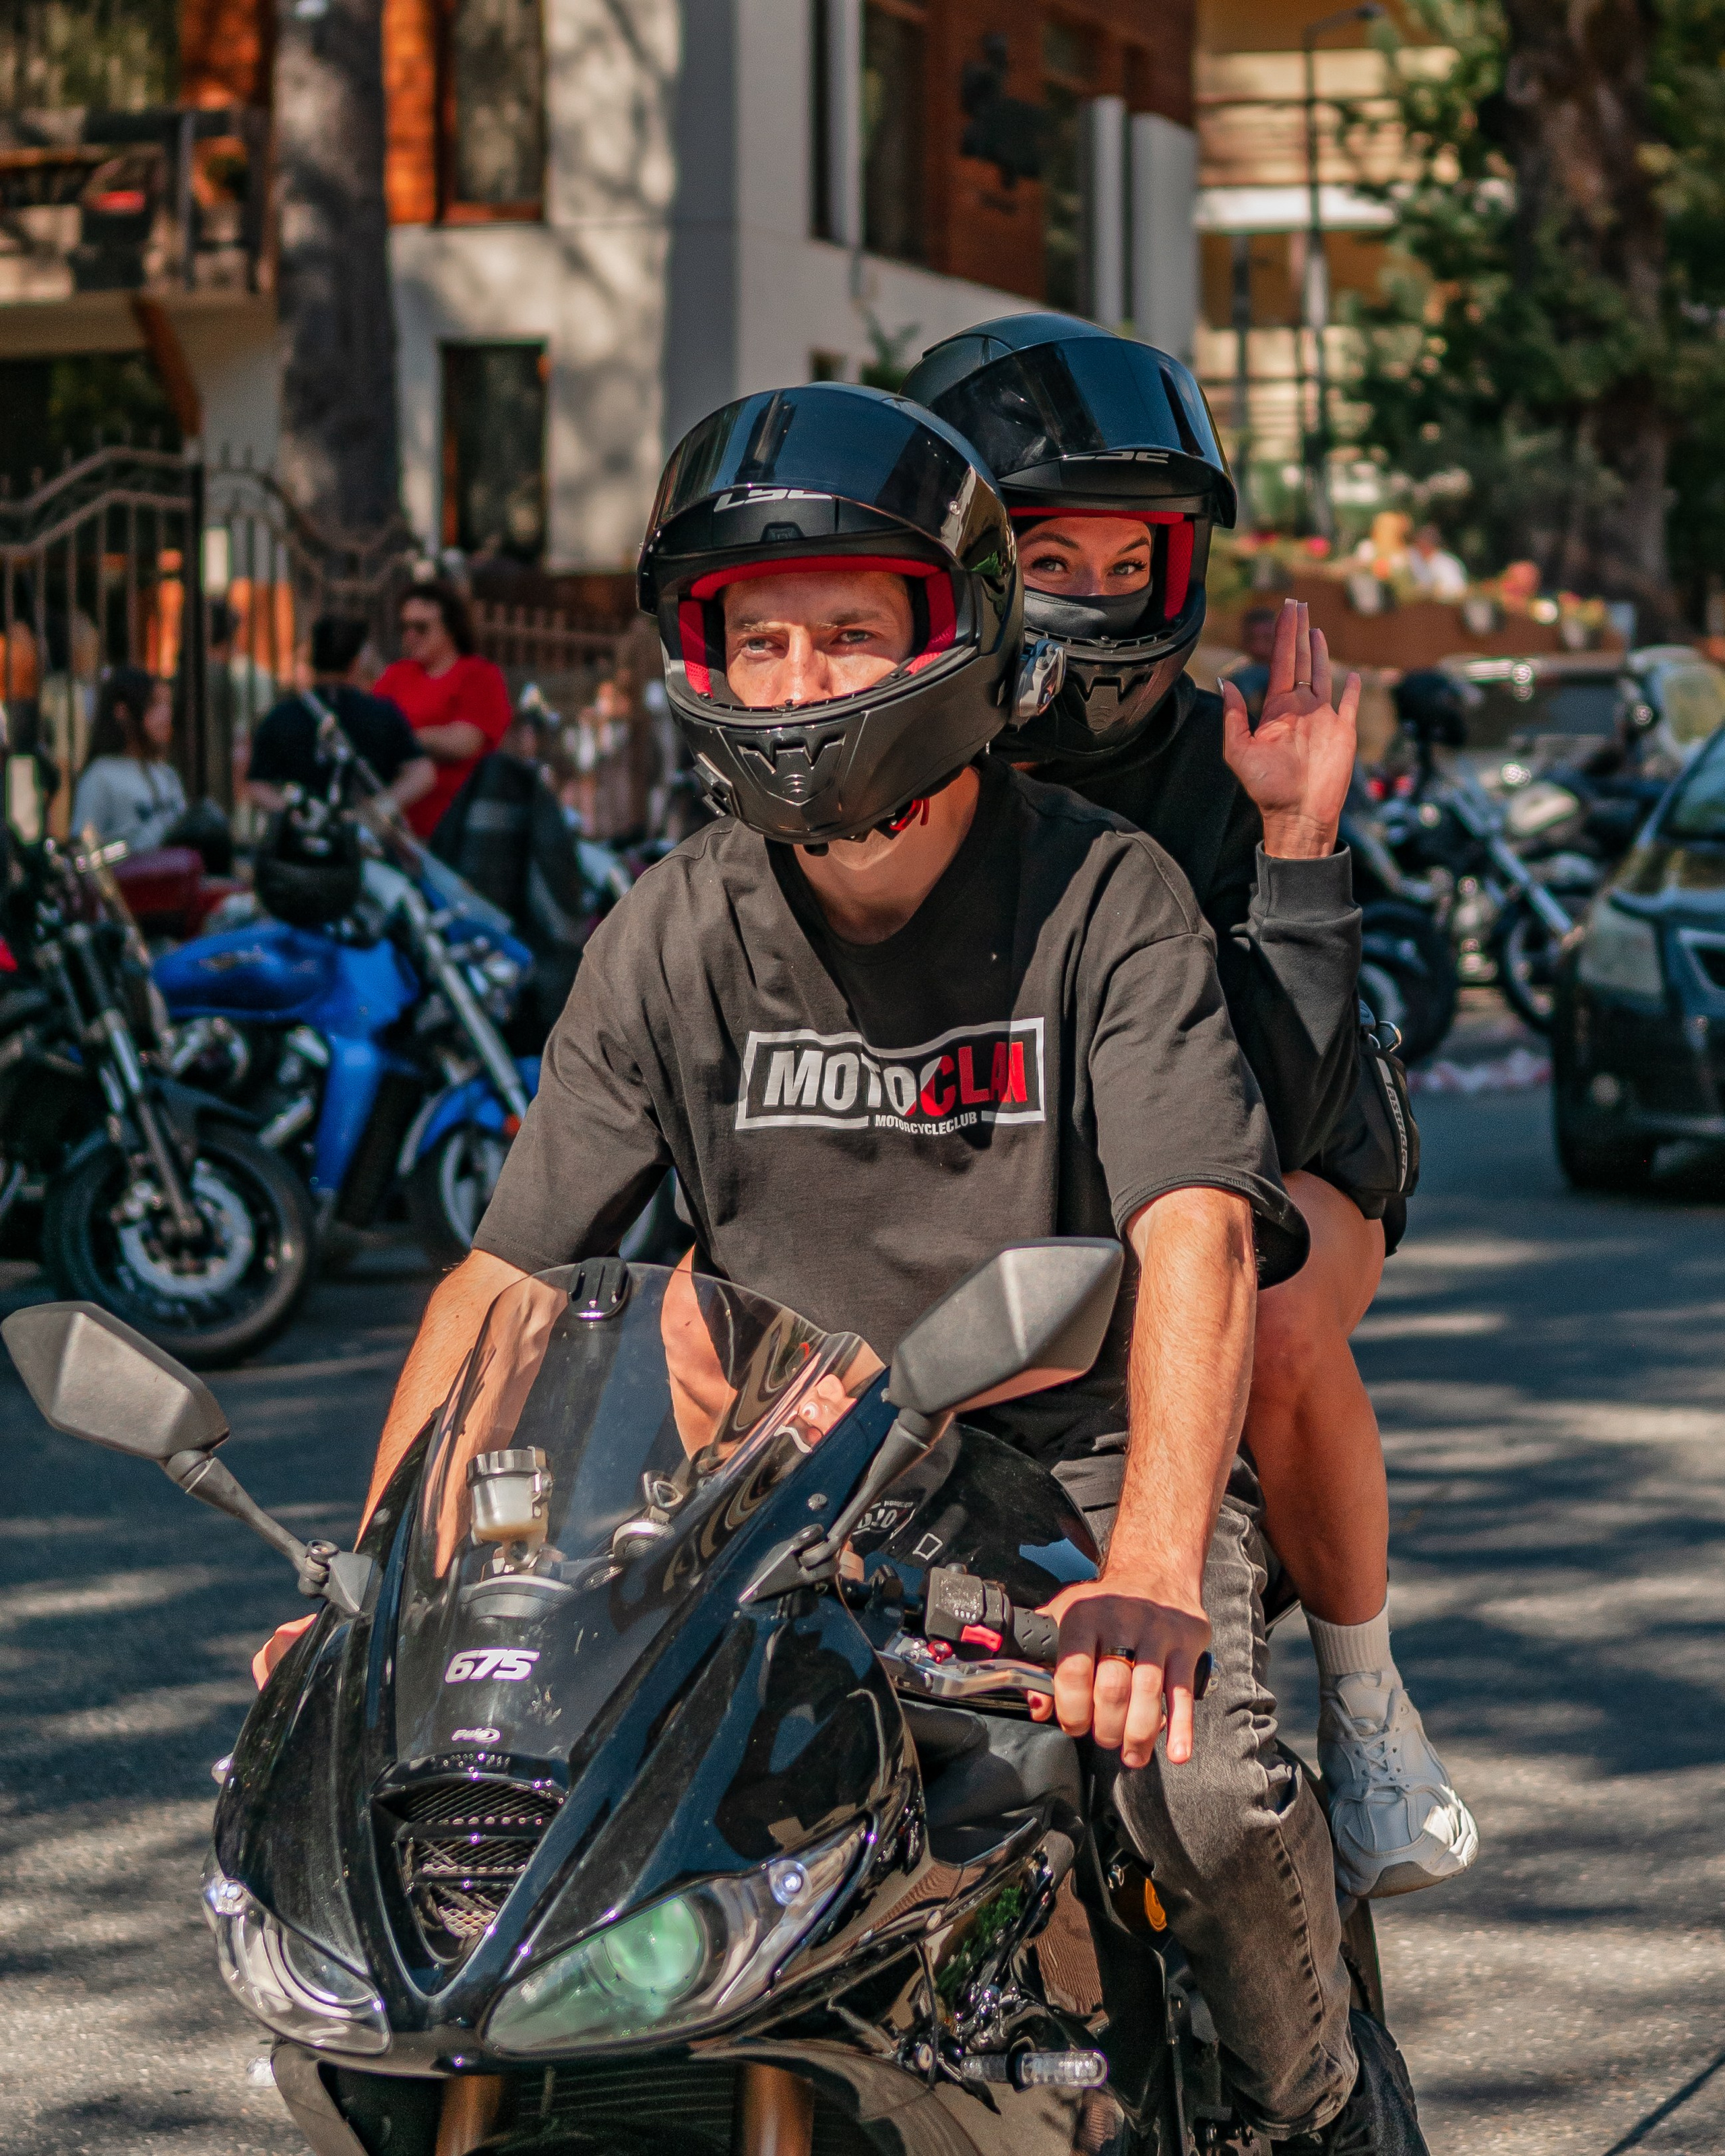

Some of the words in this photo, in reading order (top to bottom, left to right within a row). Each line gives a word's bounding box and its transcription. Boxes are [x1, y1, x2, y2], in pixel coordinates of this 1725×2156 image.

[763, 1041, 1028, 1116] MOTOCLAN
[875, 1110, 978, 1136] MOTORCYCLECLUB
[445, 1649, 540, 1683] 675
